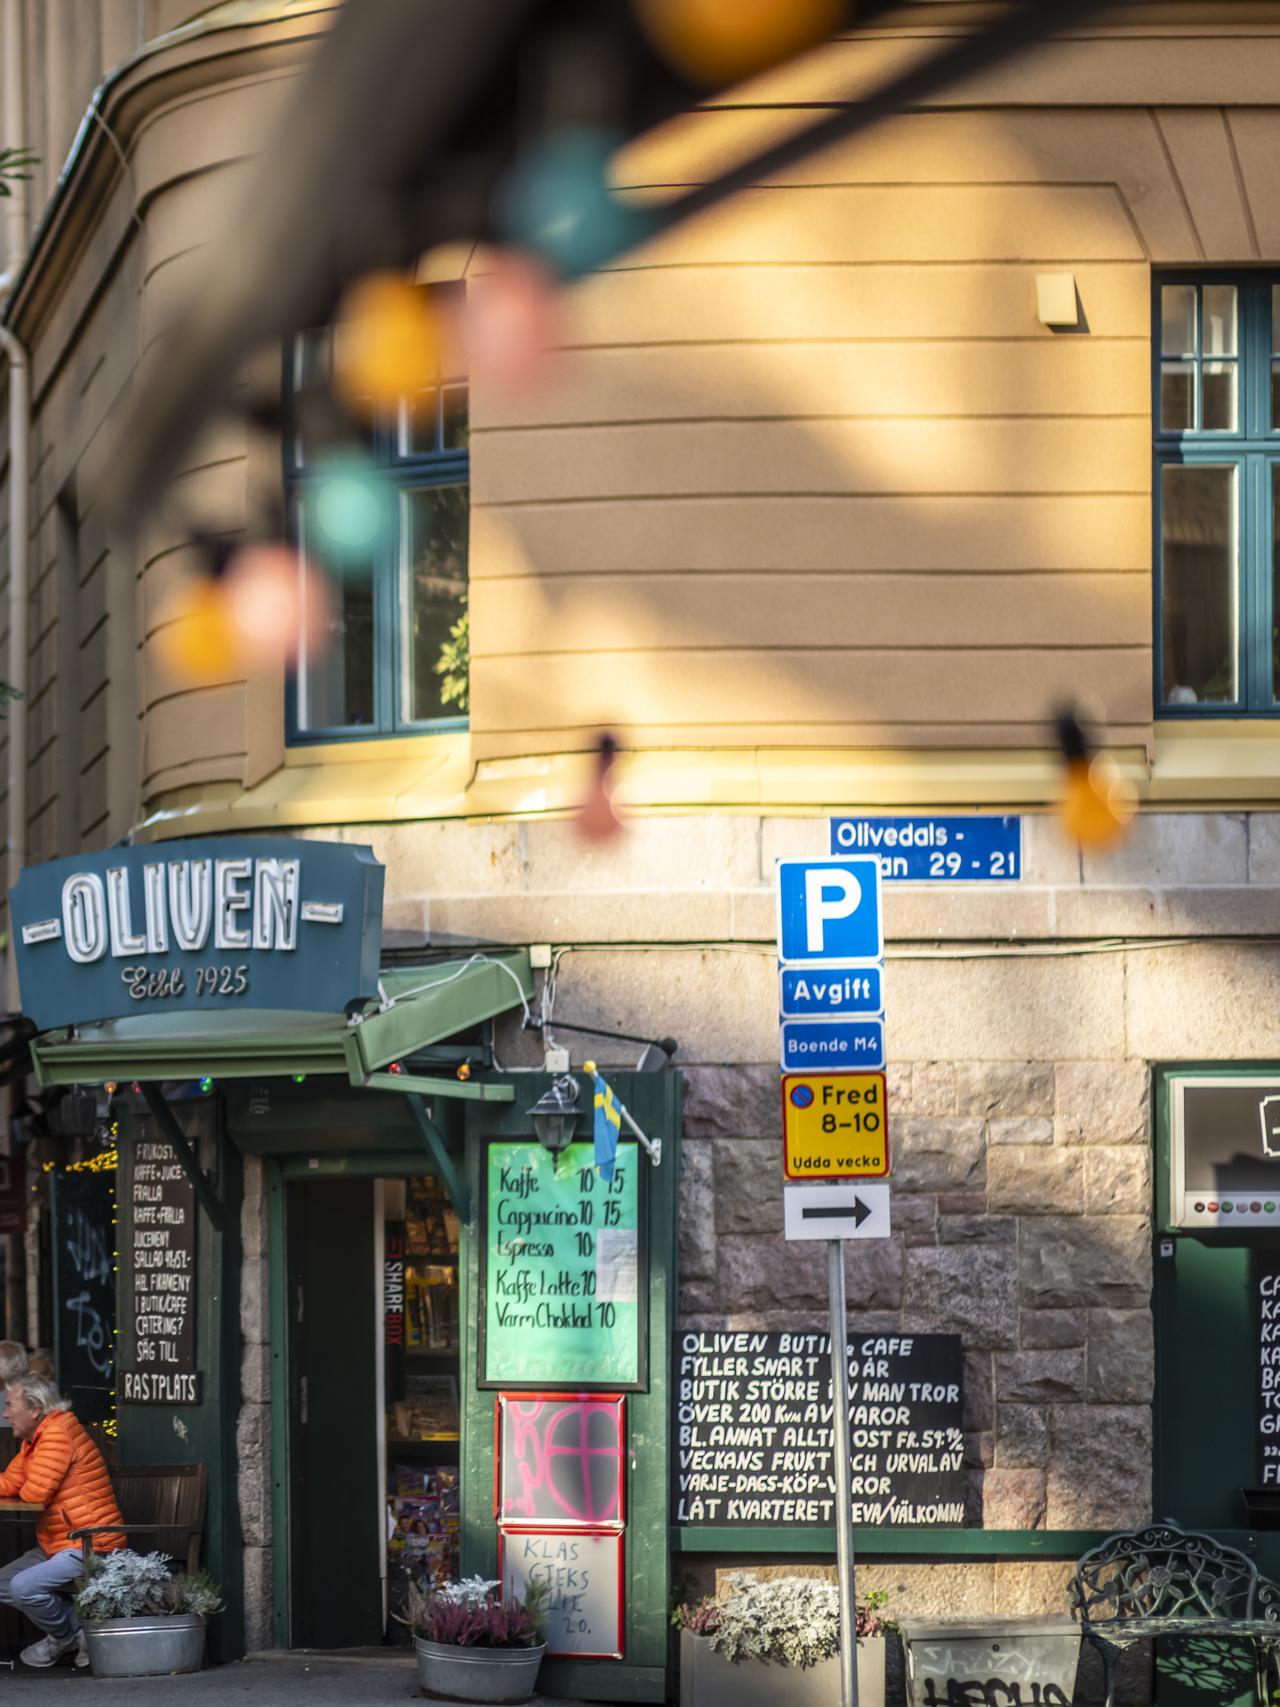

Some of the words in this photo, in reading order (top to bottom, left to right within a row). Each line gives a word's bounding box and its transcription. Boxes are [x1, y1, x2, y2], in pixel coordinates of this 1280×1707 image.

[836, 822, 948, 848] Olivedals
[195, 964, 250, 996] 1925
[793, 978, 871, 1005] Avgift
[787, 1037, 848, 1054] Boende
[854, 1036, 878, 1052] M4
[822, 1084, 878, 1105] Fred
[793, 1157, 831, 1169] Udda
[837, 1155, 881, 1168] vecka
[133, 1184, 163, 1202] FRALLA
[500, 1167, 540, 1199] Kaffe
[578, 1168, 595, 1193] 10
[577, 1200, 594, 1225] 10
[603, 1200, 621, 1226] 15
[134, 1250, 163, 1268] SALLAD
[497, 1230, 554, 1266] Espresso
[575, 1231, 593, 1257] 10
[496, 1270, 536, 1303] Kaffe
[136, 1315, 184, 1336] CATERING?
[495, 1302, 535, 1328] Varm
[536, 1302, 593, 1329] Choklad
[596, 1303, 616, 1328] 10
[159, 1341, 179, 1362] TILL
[682, 1333, 768, 1354] OLIVEN
[861, 1337, 914, 1356] CAFE
[680, 1355, 750, 1377] FYLLER
[751, 1356, 819, 1377] SNART
[862, 1357, 890, 1378] ÅR
[125, 1373, 197, 1401] RASTPLATS
[680, 1378, 740, 1401] BUTIK
[745, 1377, 820, 1401] STÖRRE
[862, 1381, 906, 1403] MAN
[909, 1382, 960, 1404] TROR
[678, 1402, 735, 1423] ÖVER
[738, 1403, 771, 1424] 200
[709, 1425, 778, 1448] ANNAT
[852, 1429, 893, 1450] OST
[679, 1450, 765, 1471] VECKANS
[771, 1451, 832, 1472] FRUKT
[885, 1453, 939, 1474] URVAL
[677, 1496, 722, 1521] LÅT
[726, 1499, 834, 1522] KVARTERET
[523, 1537, 579, 1561] KLAS
